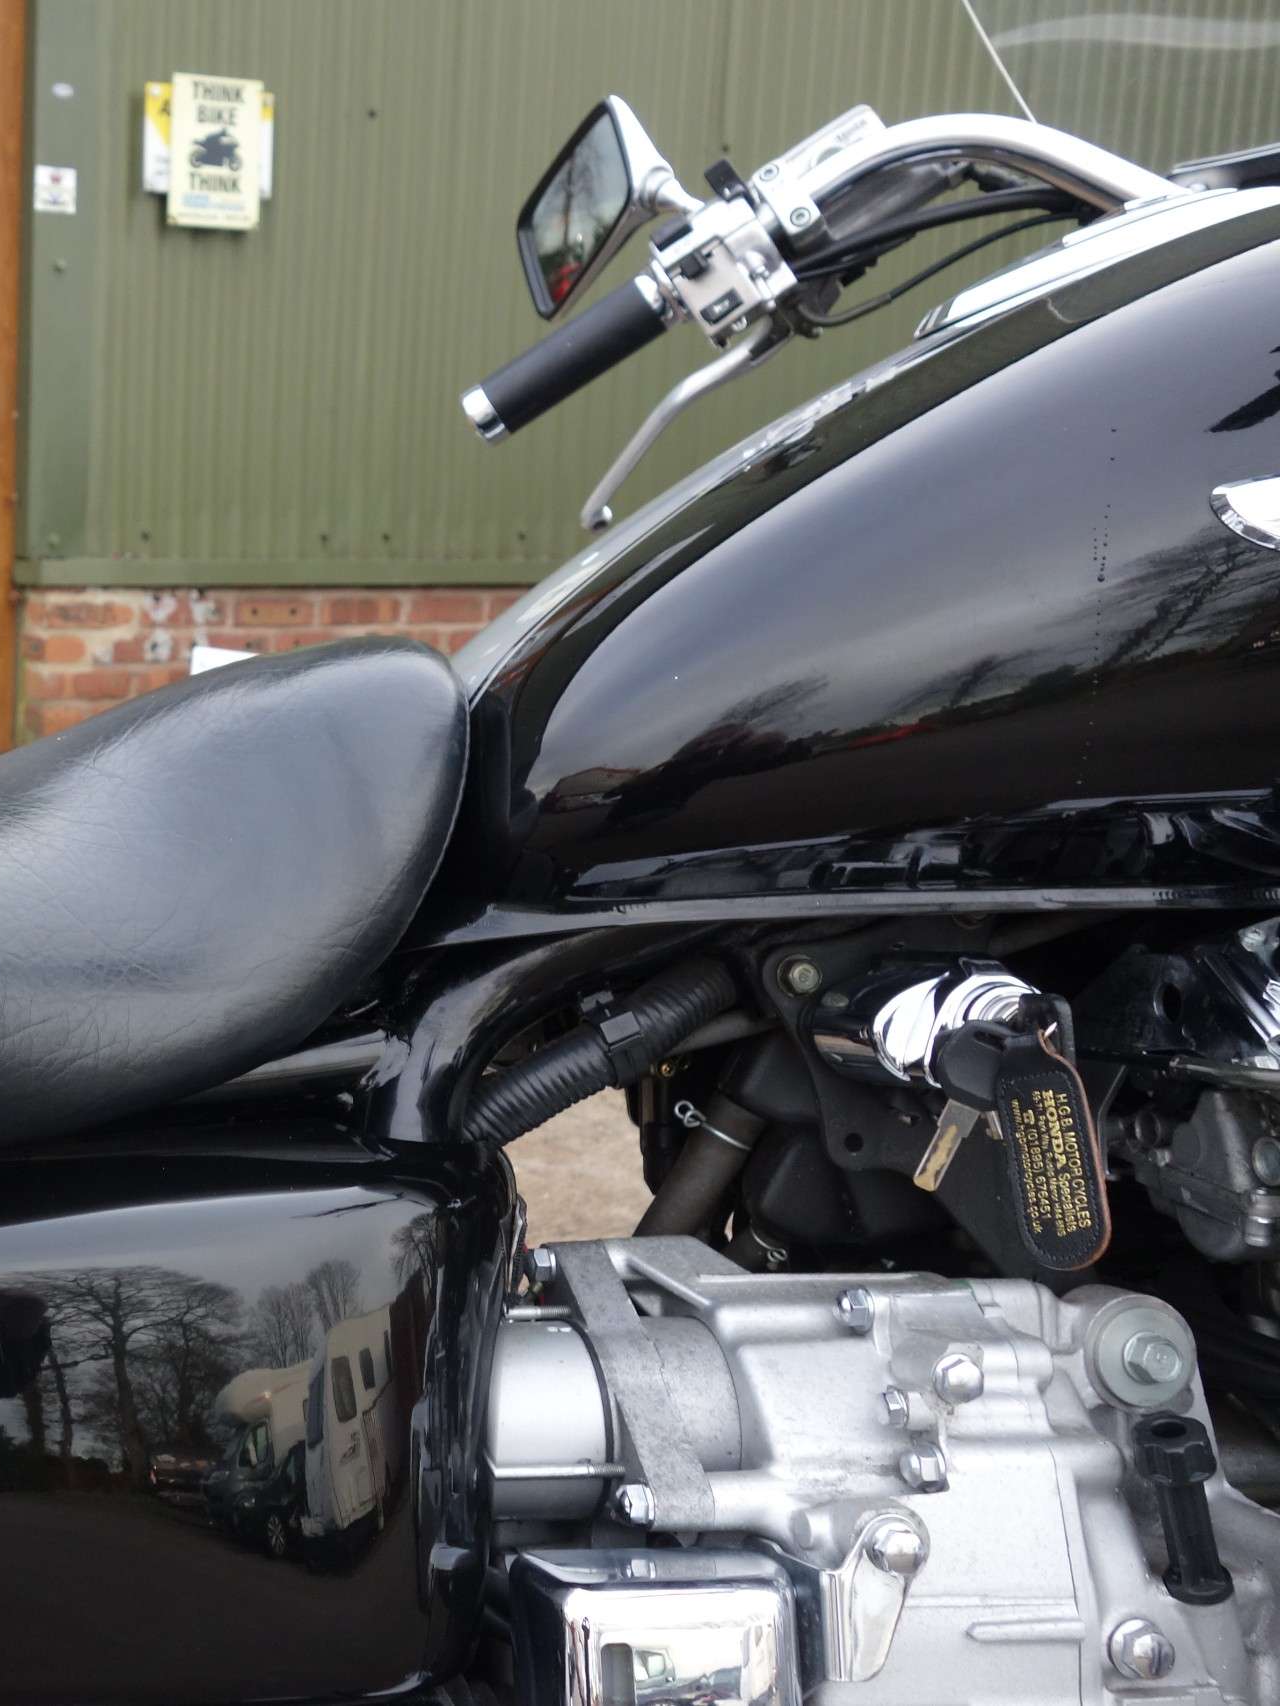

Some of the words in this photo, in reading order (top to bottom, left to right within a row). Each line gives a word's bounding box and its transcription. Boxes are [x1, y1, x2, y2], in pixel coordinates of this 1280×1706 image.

[192, 80, 245, 103] THINK
[196, 104, 237, 125] BIKE
[189, 172, 241, 192] THINK
[1056, 1093, 1073, 1131] H.G.B.
[1025, 1128, 1044, 1173] (01895)
[1035, 1175, 1052, 1220] 676451
[1042, 1089, 1067, 1169] HONDA
[1059, 1172, 1077, 1232] Specialists
[1065, 1131, 1083, 1177] MOTOR
[1072, 1178, 1091, 1229] CYCLES
